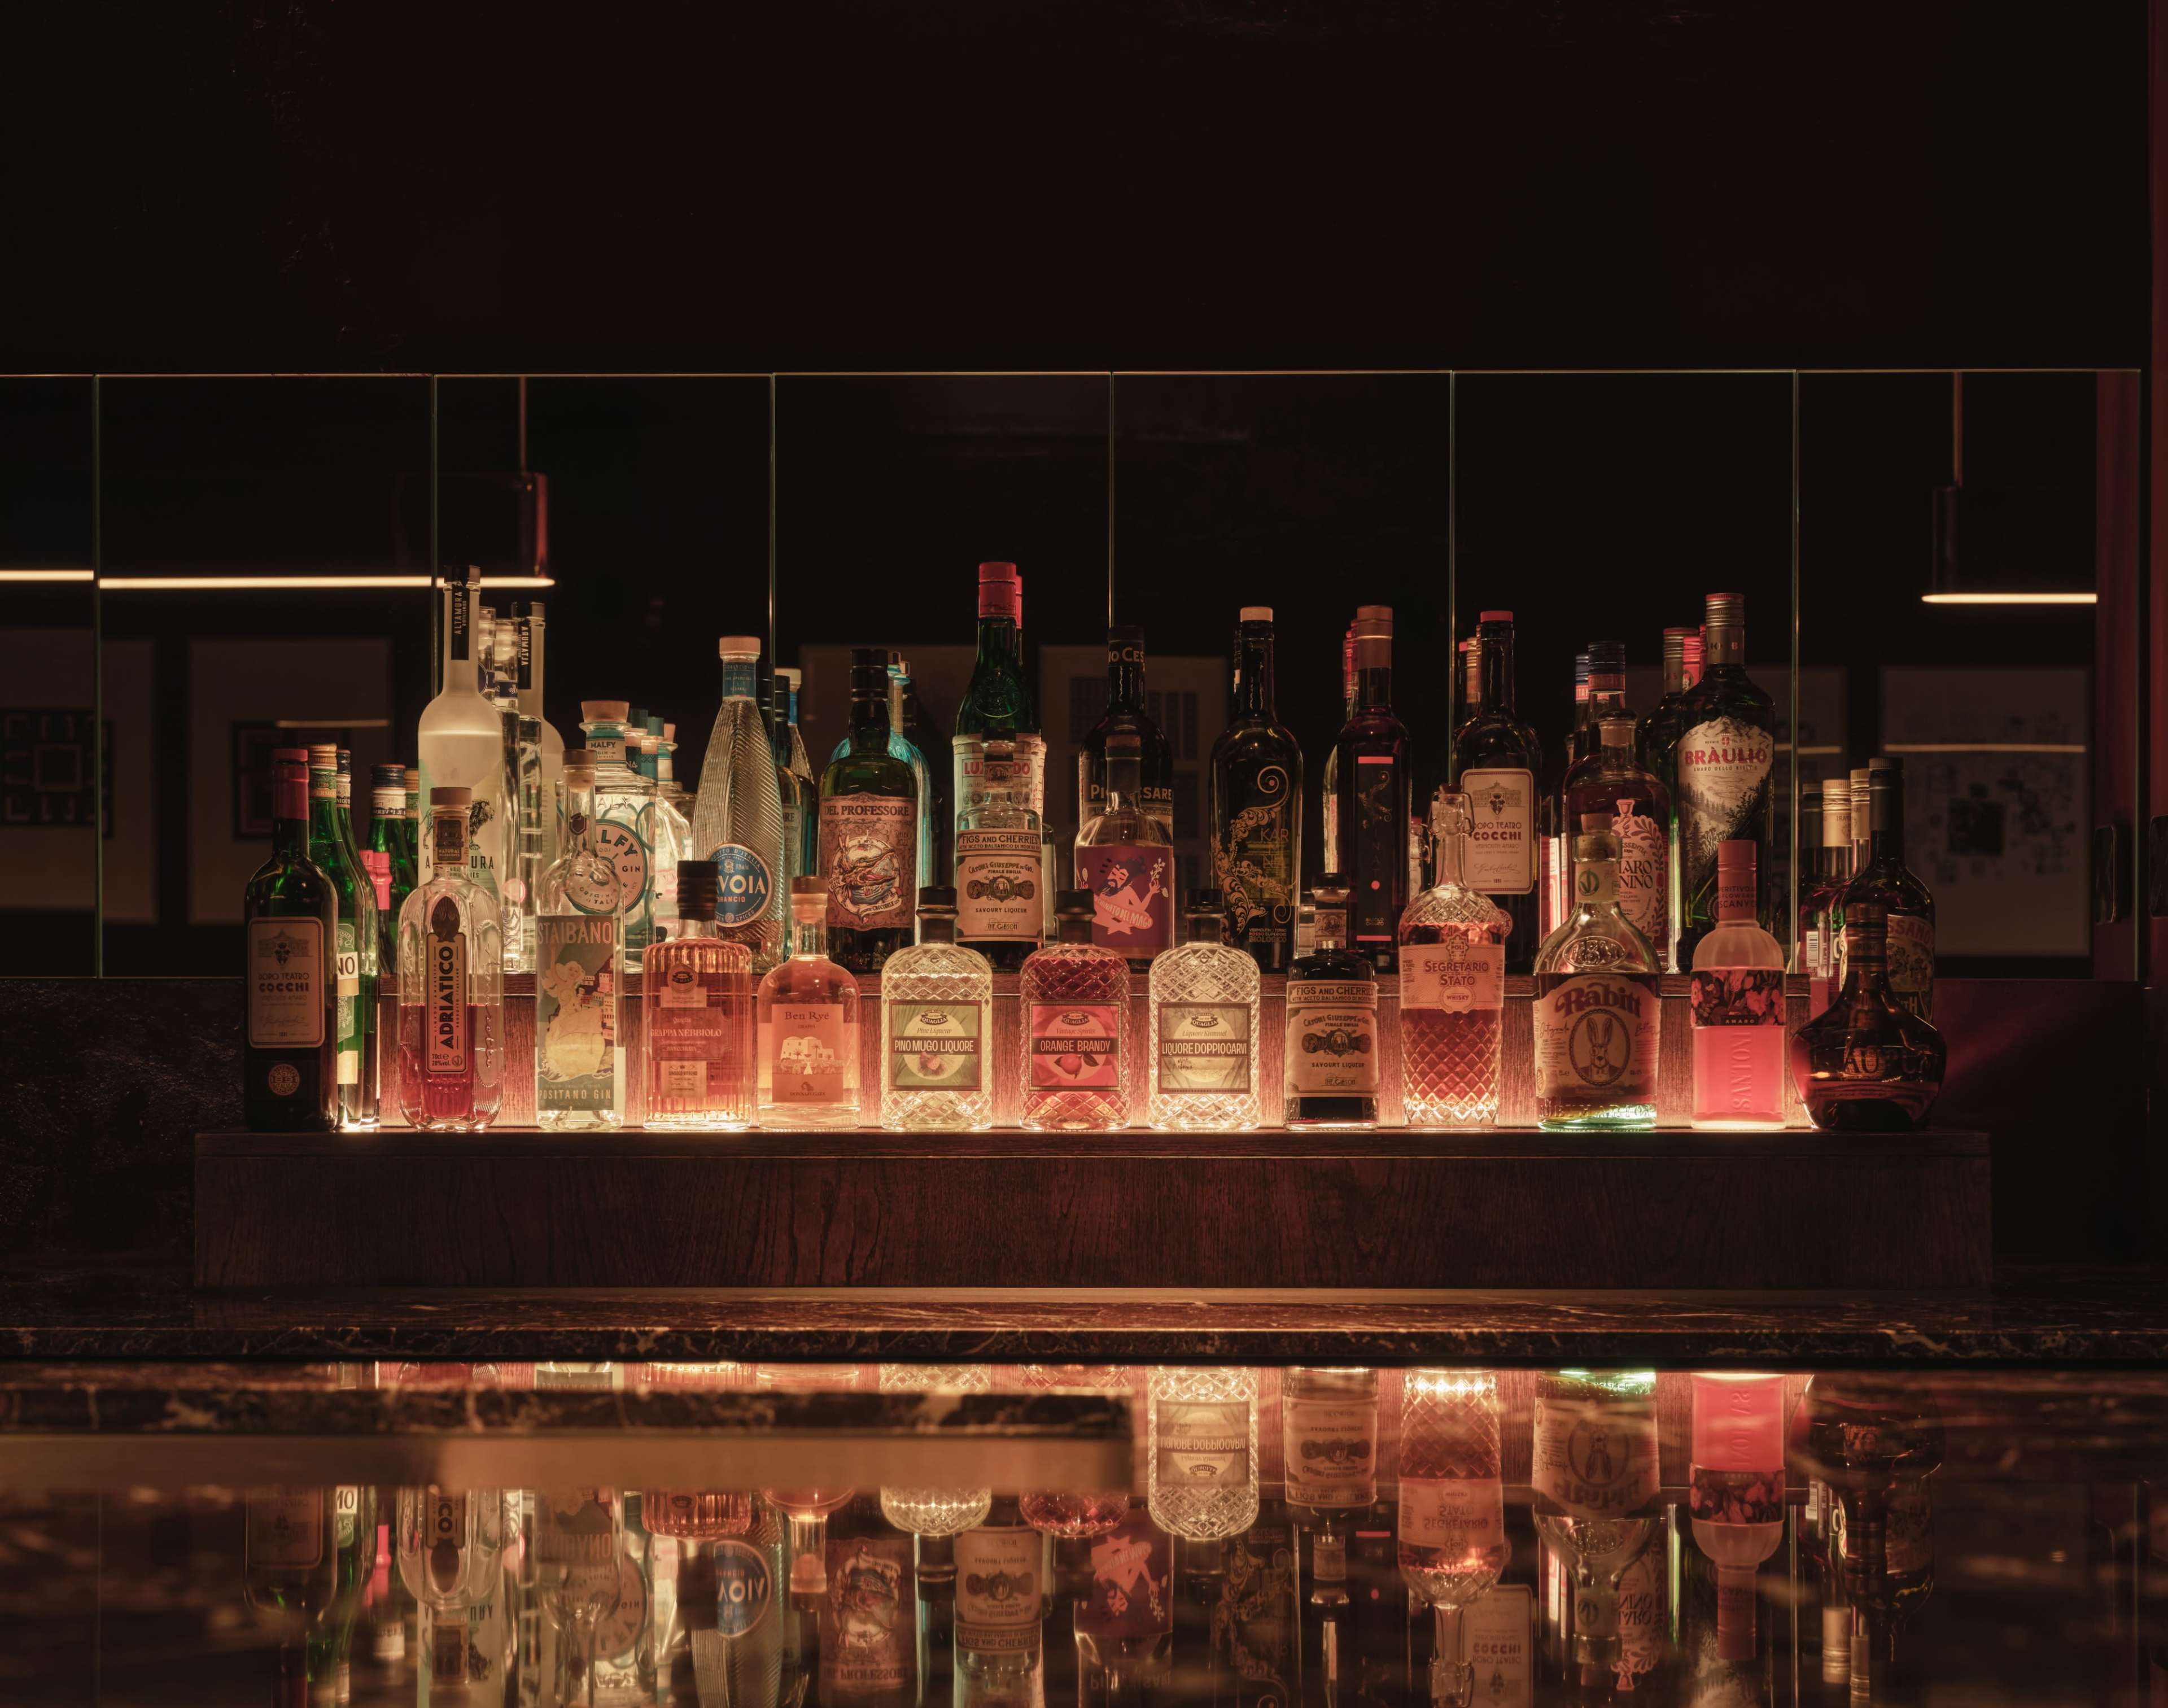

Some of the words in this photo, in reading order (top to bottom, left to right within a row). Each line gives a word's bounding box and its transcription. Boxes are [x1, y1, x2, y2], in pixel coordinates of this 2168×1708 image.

[453, 591, 463, 635] ALTAMURA
[1090, 784, 1107, 800] PI
[1140, 787, 1173, 801] SARE
[841, 805, 909, 816] PROFESSORE
[963, 835, 980, 844] FIGS
[1473, 831, 1522, 841] COCCHI
[596, 829, 639, 857] LFY
[717, 875, 767, 894] VOIA
[736, 910, 755, 921] SPICES
[1131, 912, 1152, 927] MAGO
[537, 921, 613, 944] STAIBANO
[1424, 960, 1490, 972] SEGRETARIO
[280, 972, 309, 981] TEATRO
[1440, 973, 1475, 986] STATO
[259, 982, 309, 993] COCCHI
[1296, 986, 1316, 995] FIGS
[439, 946, 454, 1049] ADRIATICO
[785, 1011, 805, 1020] Ben
[809, 1011, 830, 1022] Ryé
[930, 1027, 952, 1036] Liqueur
[894, 1040, 911, 1051] PINO
[912, 1040, 939, 1051] MUGO
[940, 1040, 974, 1053] LIQUORE
[1039, 1040, 1074, 1051] ORANGE
[1077, 1040, 1111, 1051] BRANDY
[1162, 1042, 1194, 1055] LIQUORE
[1194, 1042, 1226, 1054] DOPPIO
[539, 1089, 587, 1100] POSITANO
[593, 1089, 611, 1100] GIN
